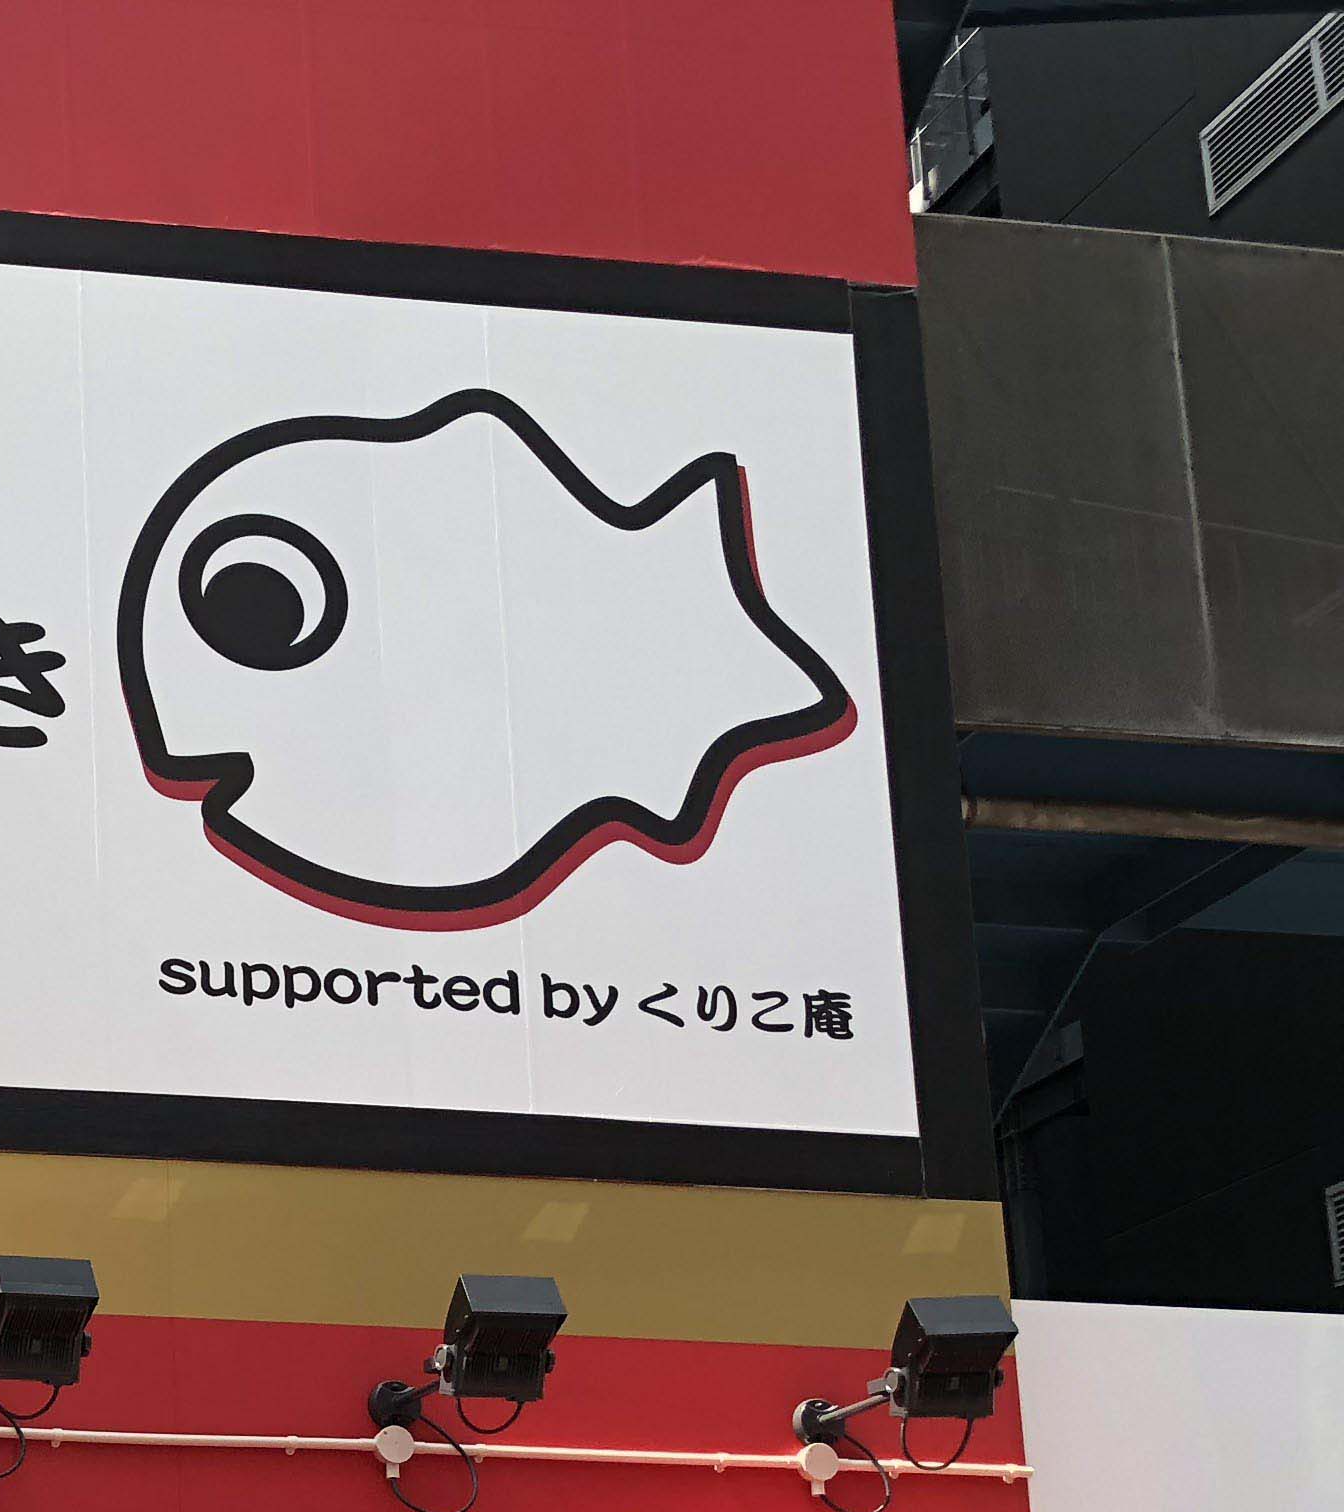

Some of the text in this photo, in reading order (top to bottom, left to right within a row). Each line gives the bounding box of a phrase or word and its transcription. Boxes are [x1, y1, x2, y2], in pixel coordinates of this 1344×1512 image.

[159, 957, 855, 1040] supported by くりこ庵
